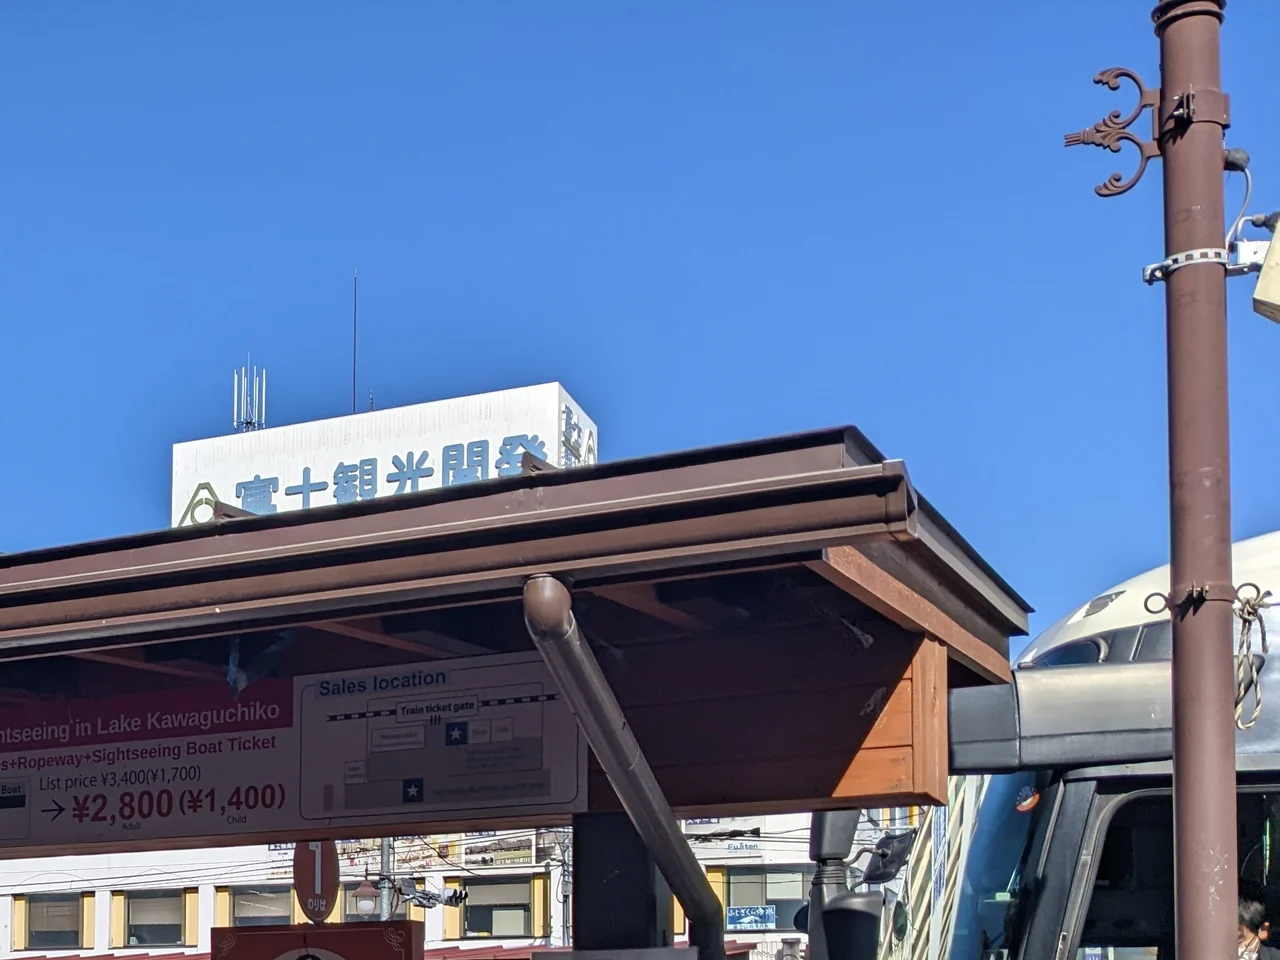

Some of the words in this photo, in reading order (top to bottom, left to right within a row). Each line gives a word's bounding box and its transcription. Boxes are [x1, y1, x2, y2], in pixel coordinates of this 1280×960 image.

[319, 680, 367, 696] Sales
[373, 671, 447, 691] location
[401, 706, 424, 716] Train
[426, 703, 452, 713] ticket
[453, 701, 475, 713] gate
[75, 719, 92, 737] in
[97, 714, 142, 736] Lake
[147, 701, 280, 730] Kawaguchiko
[187, 738, 223, 756] Boat
[228, 735, 277, 752] Ticket
[1, 785, 21, 795] Boat
[39, 776, 61, 791] List
[65, 773, 97, 793] price
[72, 787, 174, 827] ¥2,800
[179, 783, 287, 816] (¥1,400)
[122, 822, 142, 831] Adult
[226, 815, 247, 825] Child
[307, 898, 327, 912] のりば
